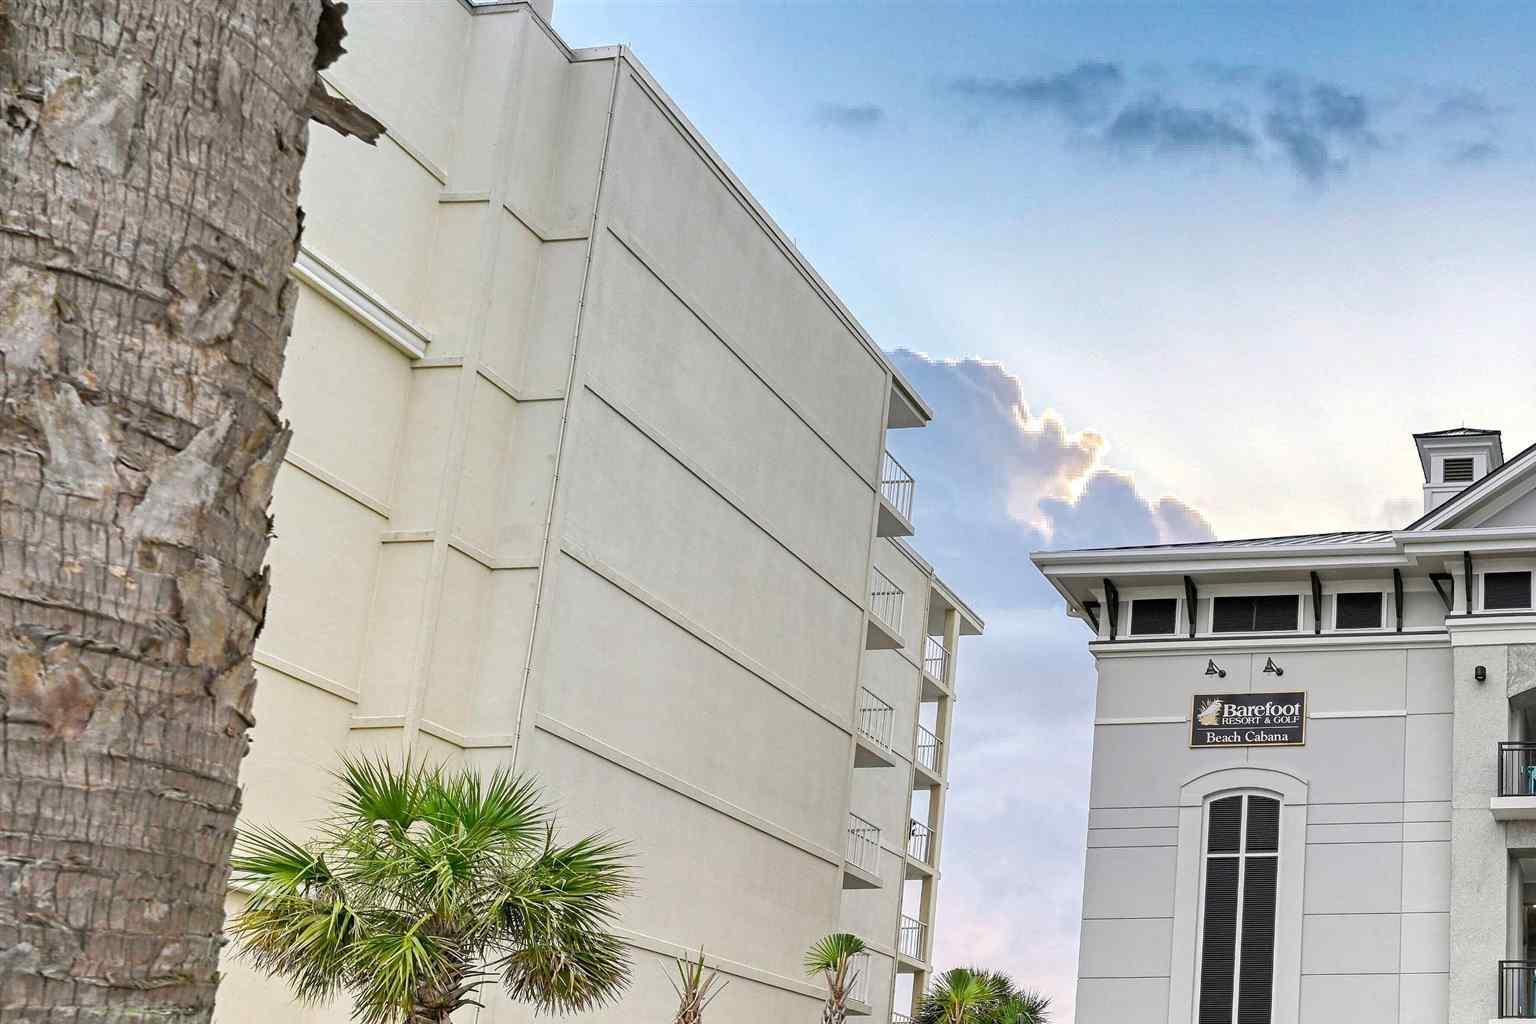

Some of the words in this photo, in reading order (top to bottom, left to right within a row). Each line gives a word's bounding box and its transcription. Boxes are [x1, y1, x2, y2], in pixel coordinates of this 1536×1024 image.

[1223, 702, 1301, 717] Barefoot
[1222, 717, 1261, 725] RESORT
[1263, 716, 1271, 724] &
[1273, 716, 1300, 724] GOLF
[1206, 731, 1241, 743] Beach
[1245, 730, 1288, 742] Cabana
